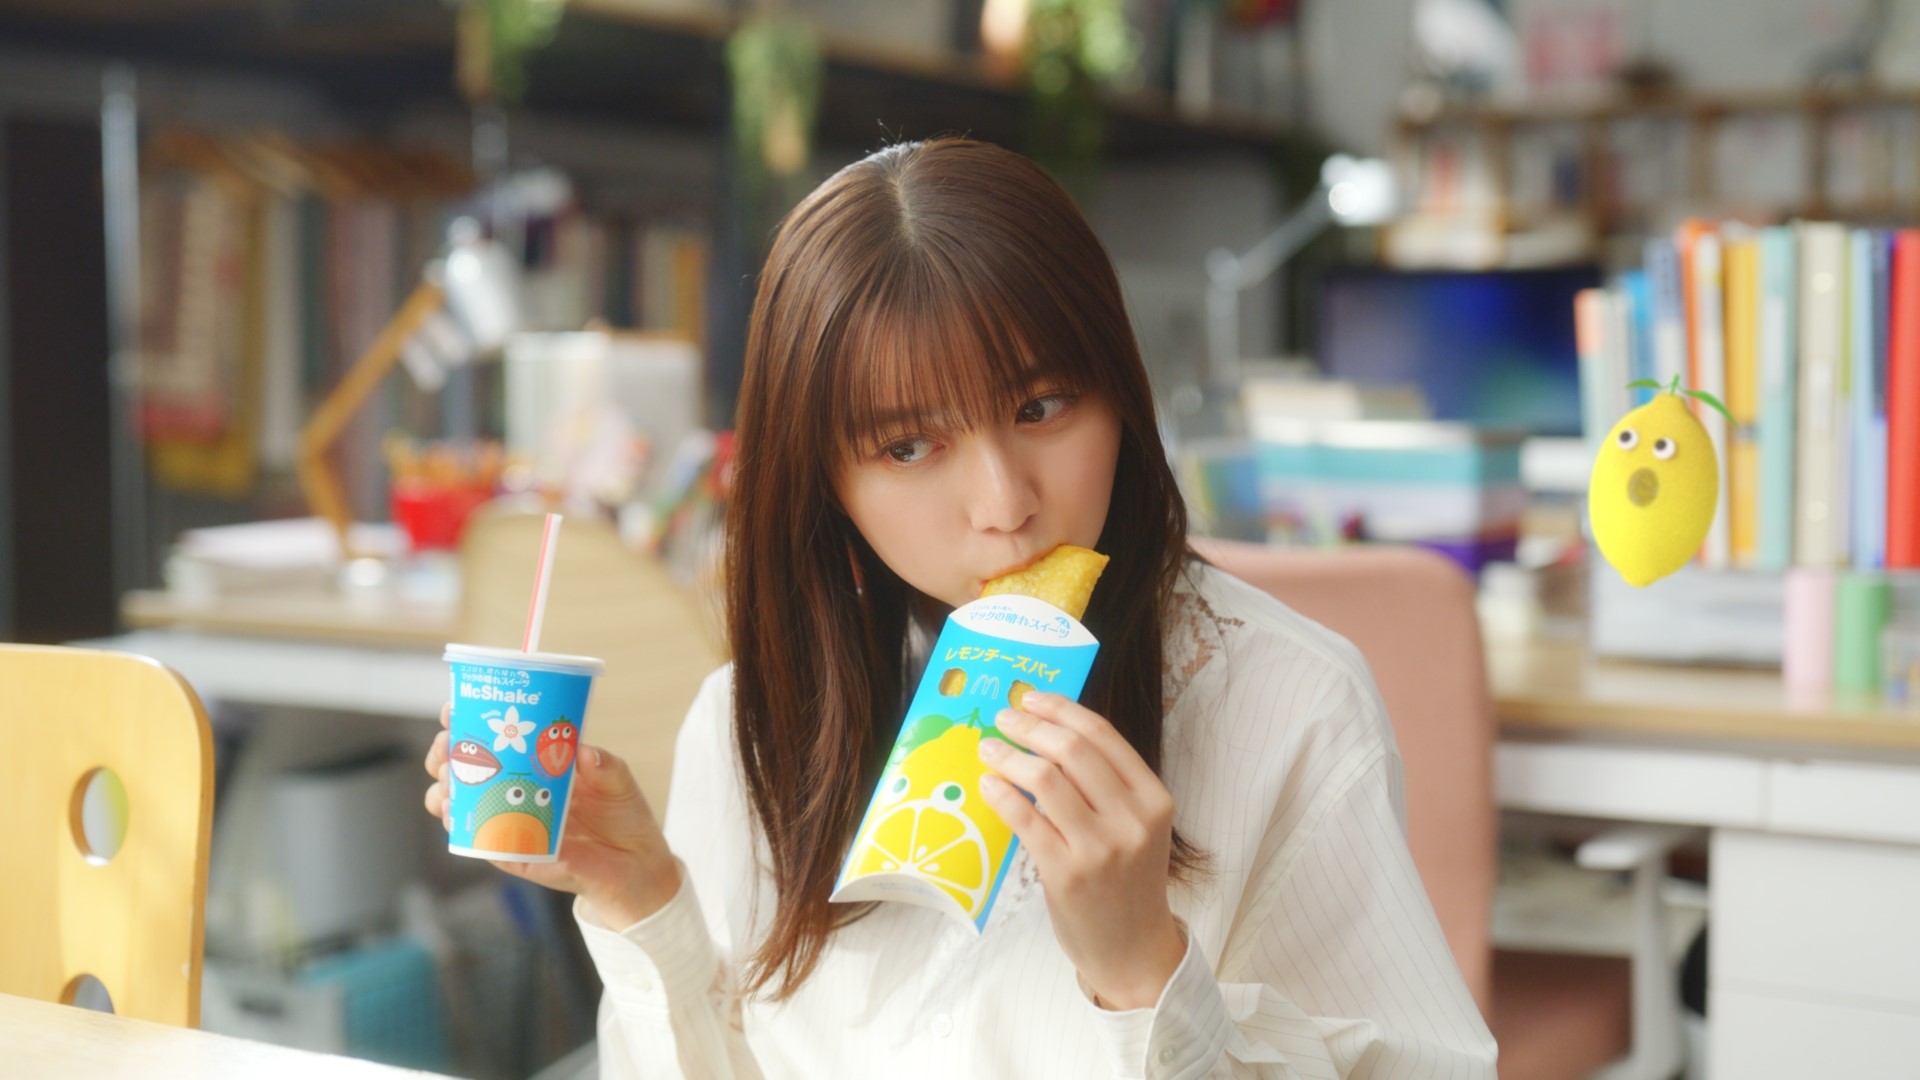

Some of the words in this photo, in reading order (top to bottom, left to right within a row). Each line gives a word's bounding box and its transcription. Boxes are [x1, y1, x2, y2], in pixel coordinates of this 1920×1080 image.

[944, 646, 1061, 683] レモンチーズパイ
